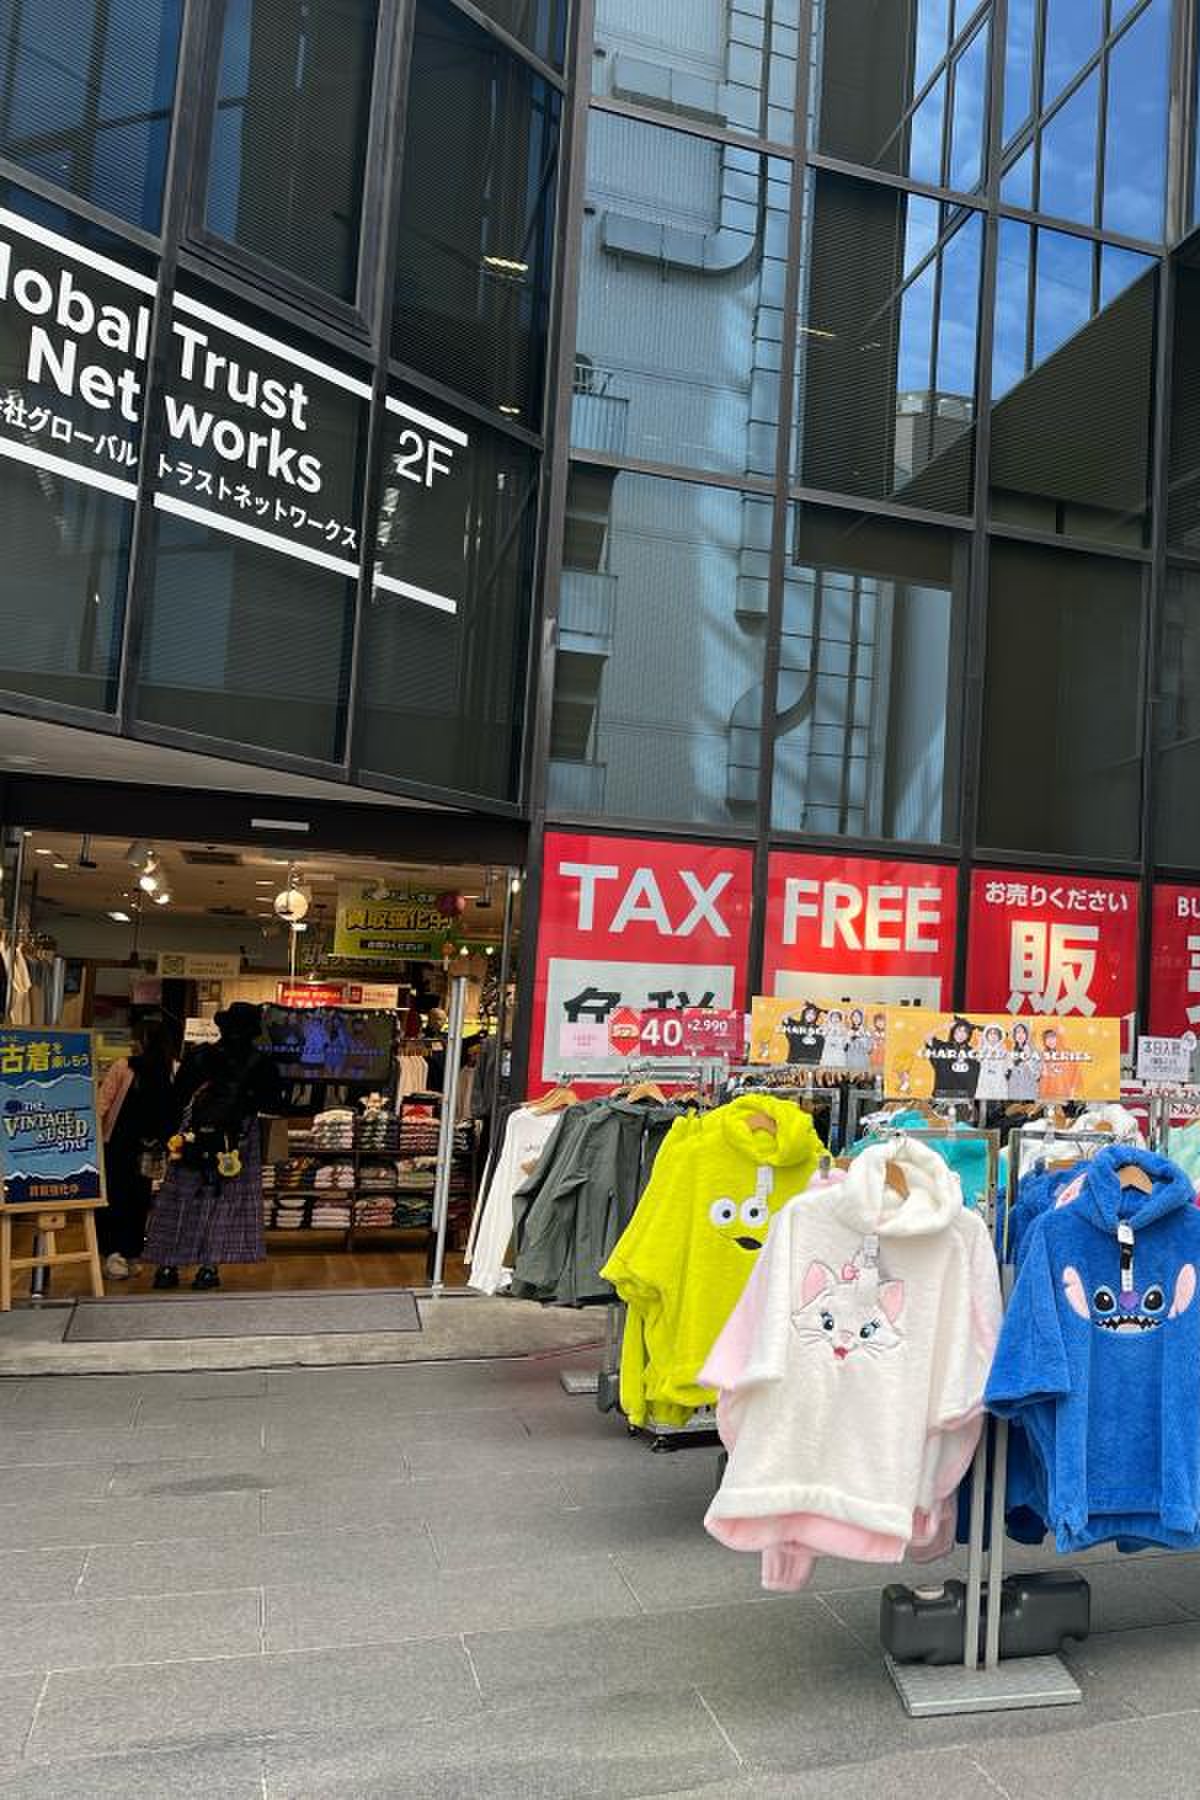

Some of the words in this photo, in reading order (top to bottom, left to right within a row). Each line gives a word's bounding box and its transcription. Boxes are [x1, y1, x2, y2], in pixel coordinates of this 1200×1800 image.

[172, 321, 309, 431] Trust
[396, 431, 454, 488] 2F
[559, 861, 734, 938] TAX
[782, 877, 942, 953] FREE
[985, 881, 1129, 912] お売りください
[641, 1018, 683, 1047] 40
[3, 1110, 76, 1138] VINTAGE
[47, 1119, 88, 1144] USED
